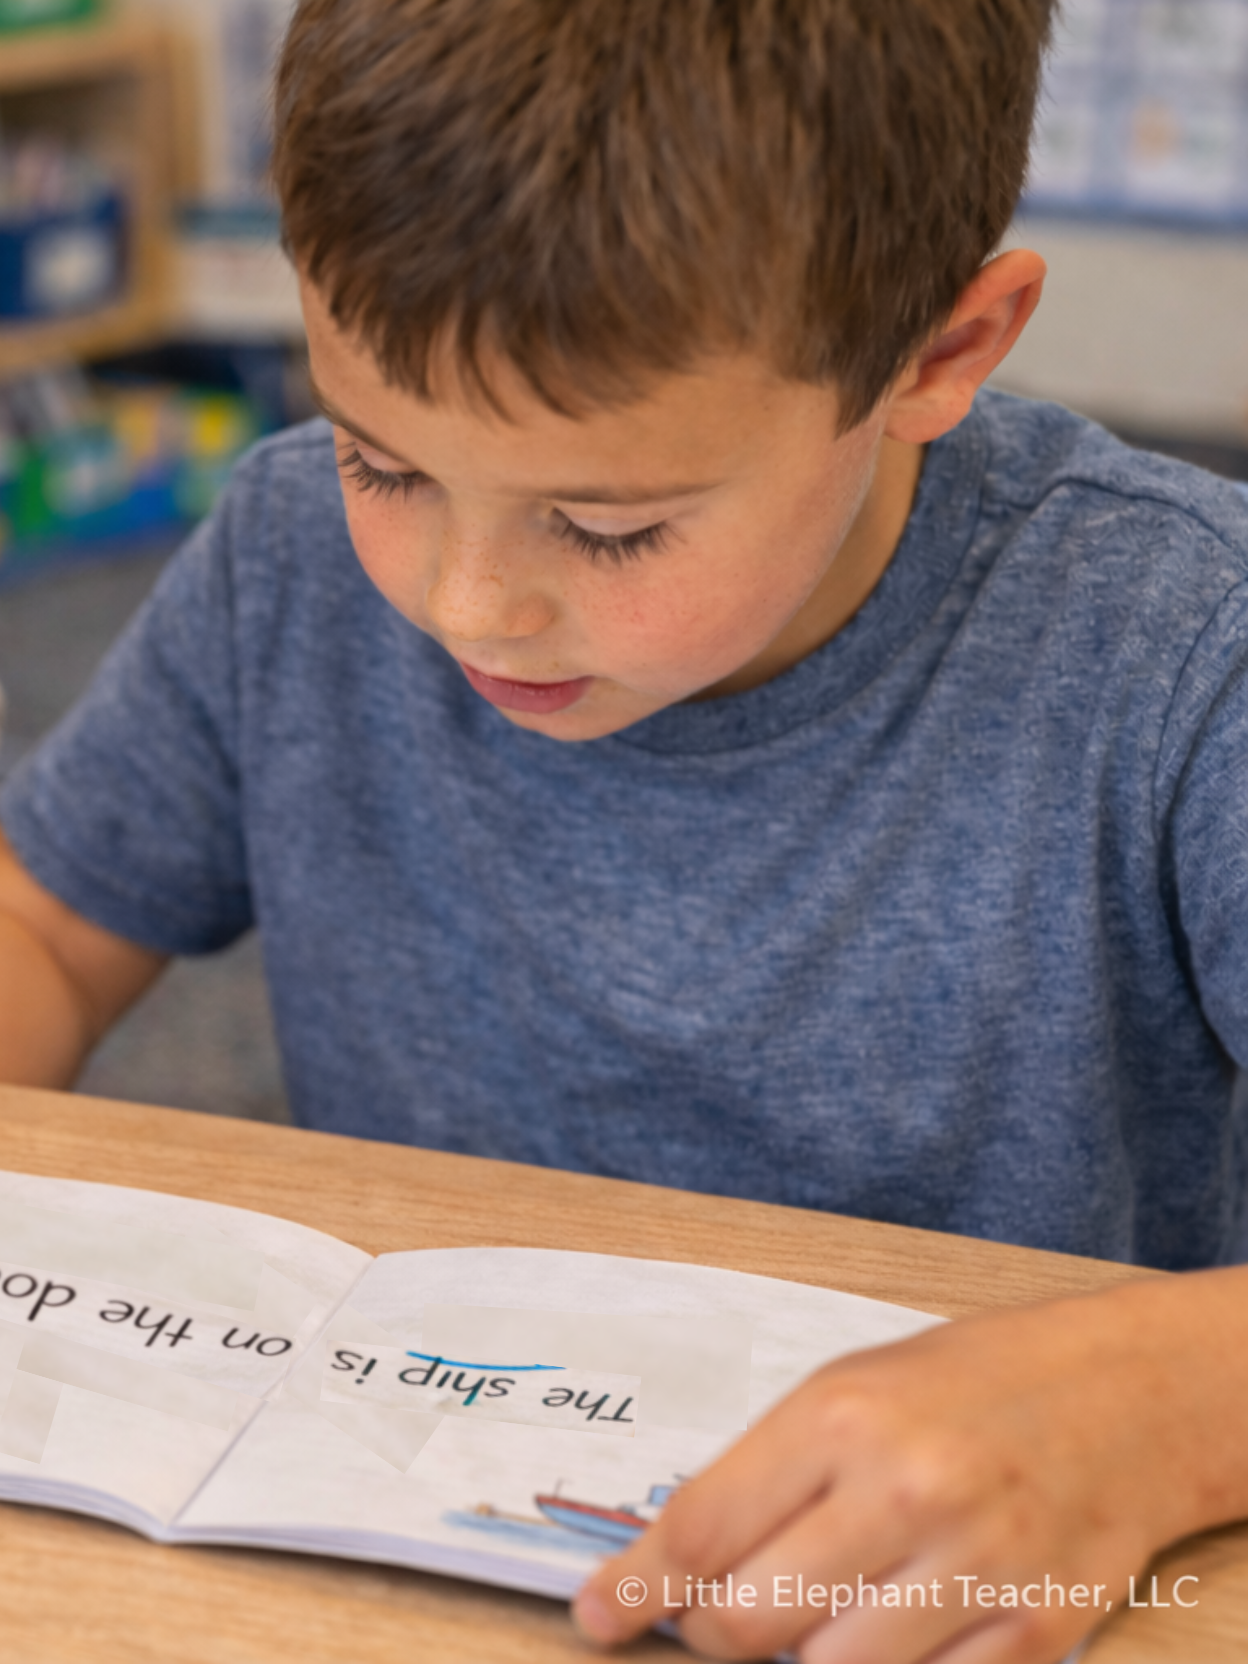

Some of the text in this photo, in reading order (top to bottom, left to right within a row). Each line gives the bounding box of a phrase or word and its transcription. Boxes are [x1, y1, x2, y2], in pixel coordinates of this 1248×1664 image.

[98, 1299, 193, 1348] the
[221, 1327, 293, 1357] on
[330, 1349, 634, 1422] The ship is
